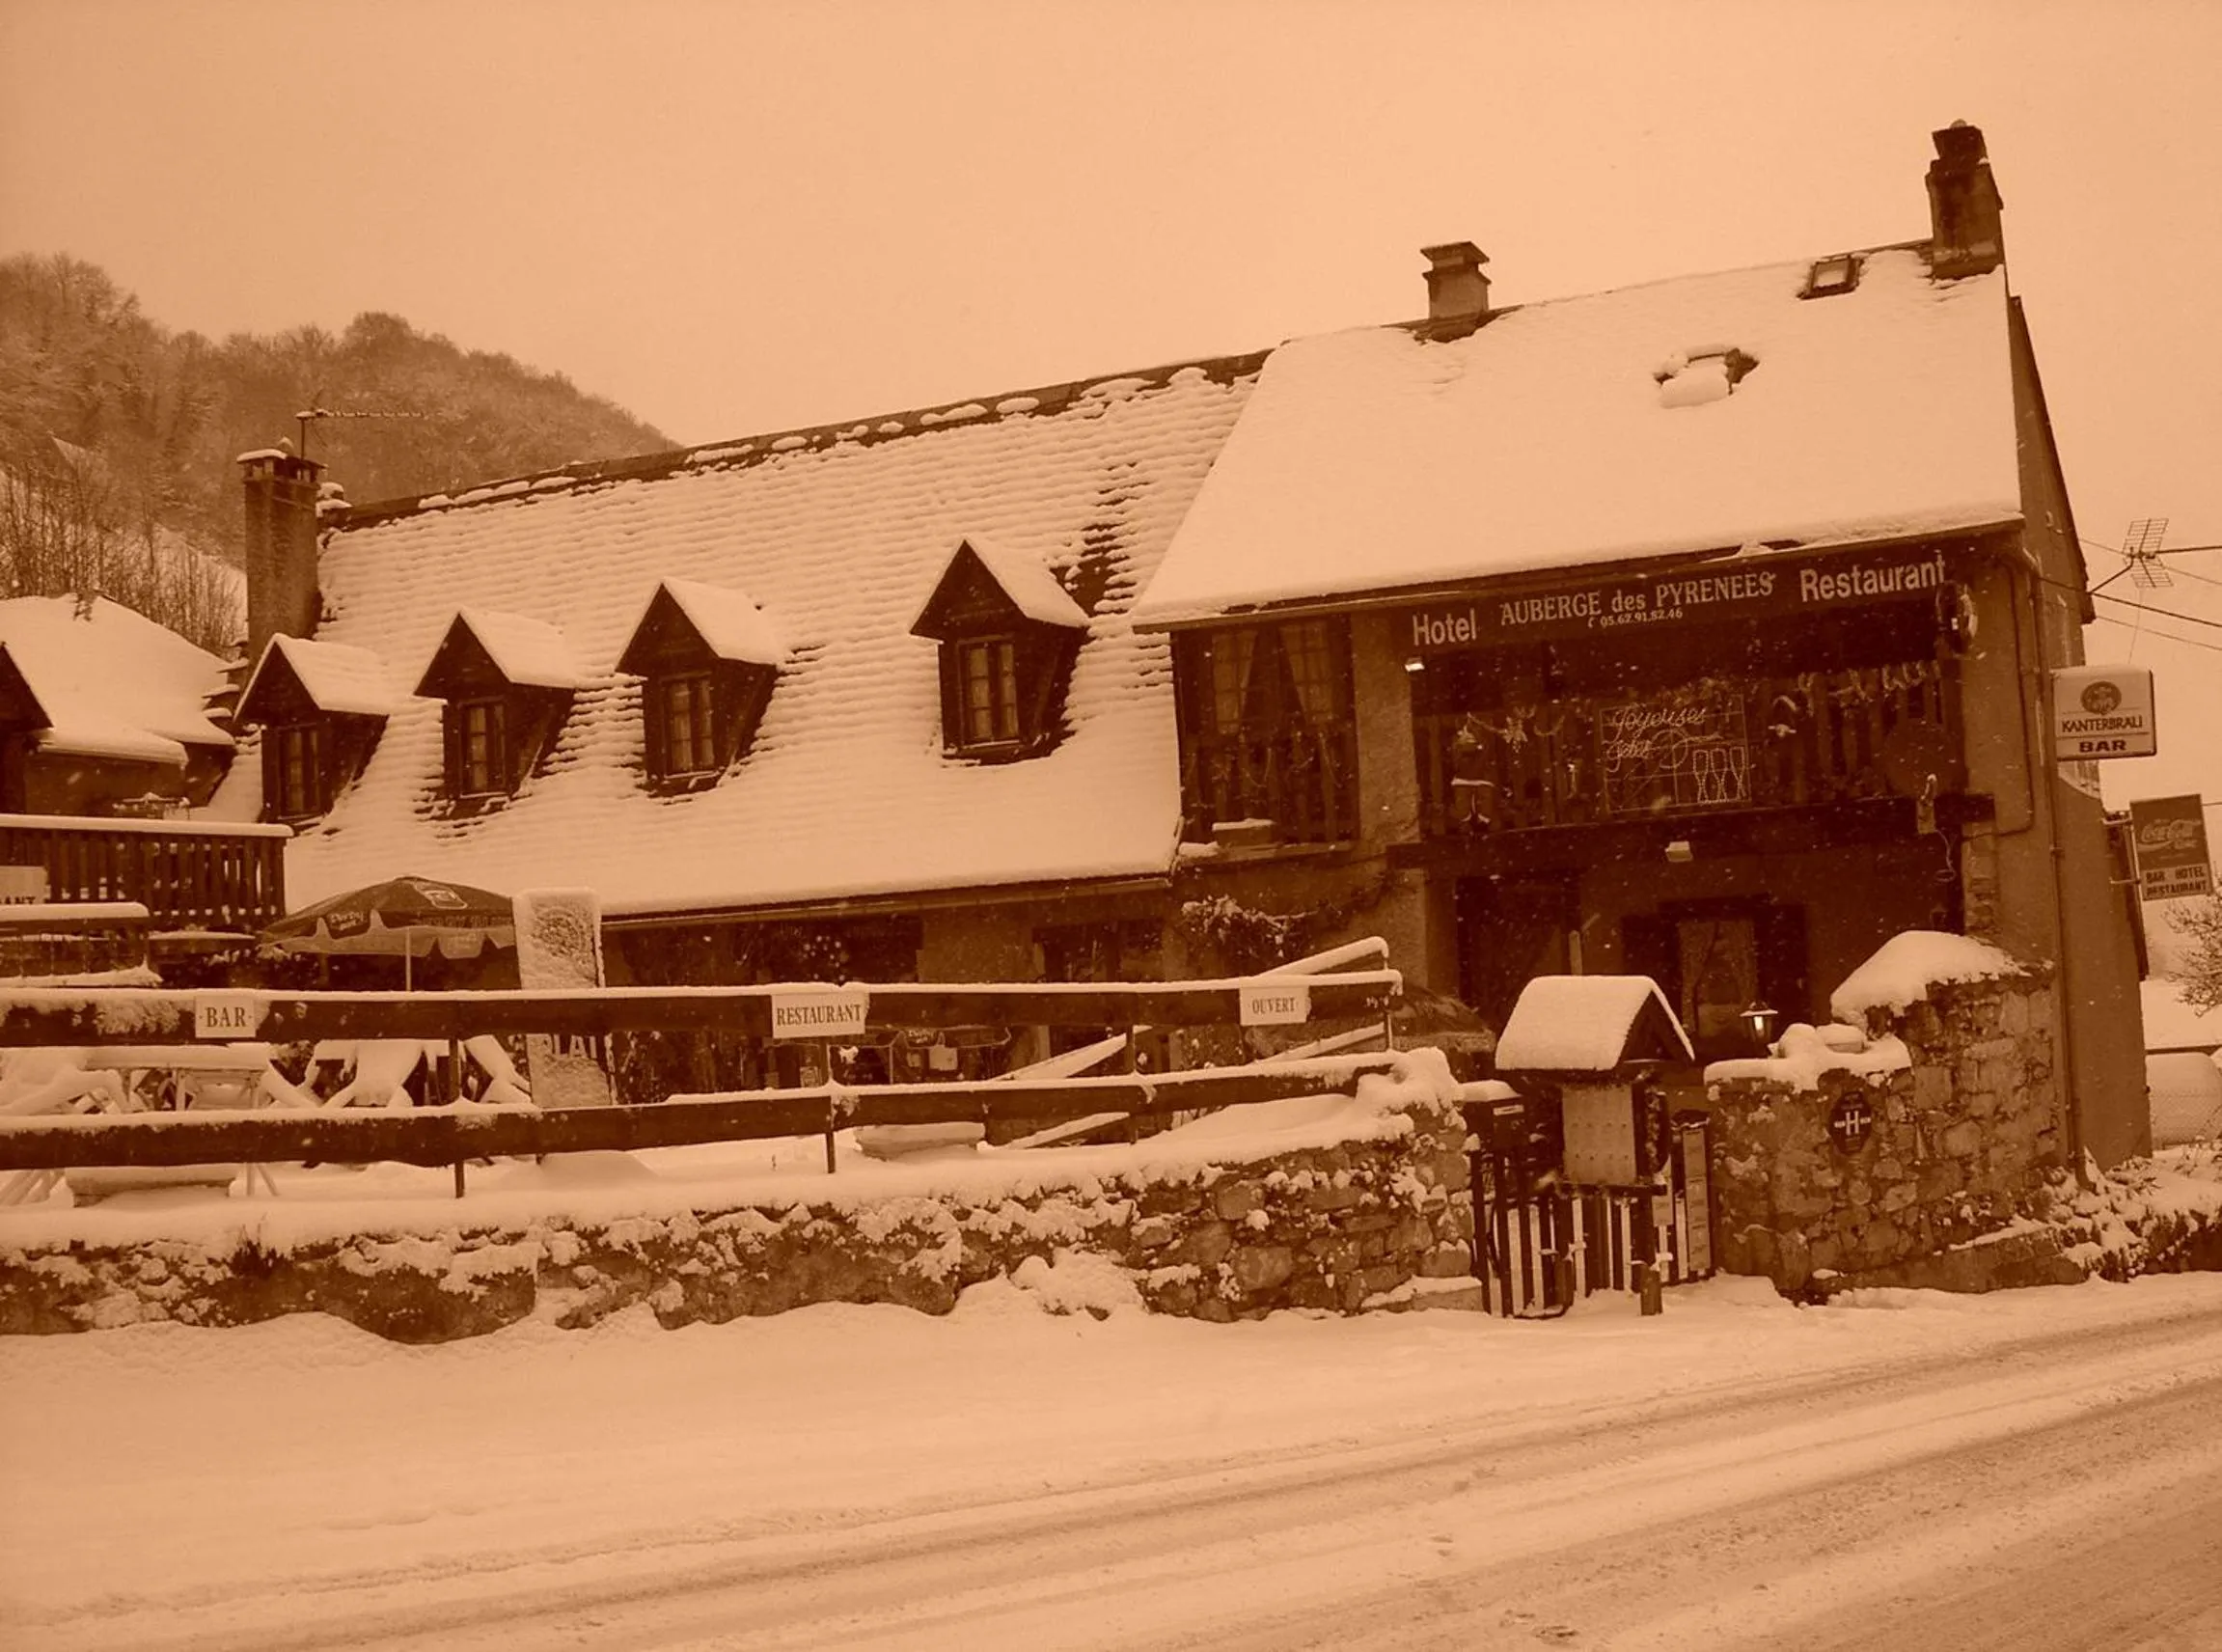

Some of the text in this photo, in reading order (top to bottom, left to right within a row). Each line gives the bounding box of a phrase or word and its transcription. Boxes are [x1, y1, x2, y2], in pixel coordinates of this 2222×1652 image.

[1413, 551, 1946, 647] Hotel AUBERGE des PYRENEES Restaurant
[2079, 739, 2127, 753] BAR
[2146, 866, 2206, 884] BAR HOTEL
[2146, 879, 2207, 895] RESTAURANT
[1251, 997, 1296, 1014] OUVERT
[206, 1006, 246, 1028] BAR
[777, 1004, 862, 1026] RESTAURANT
